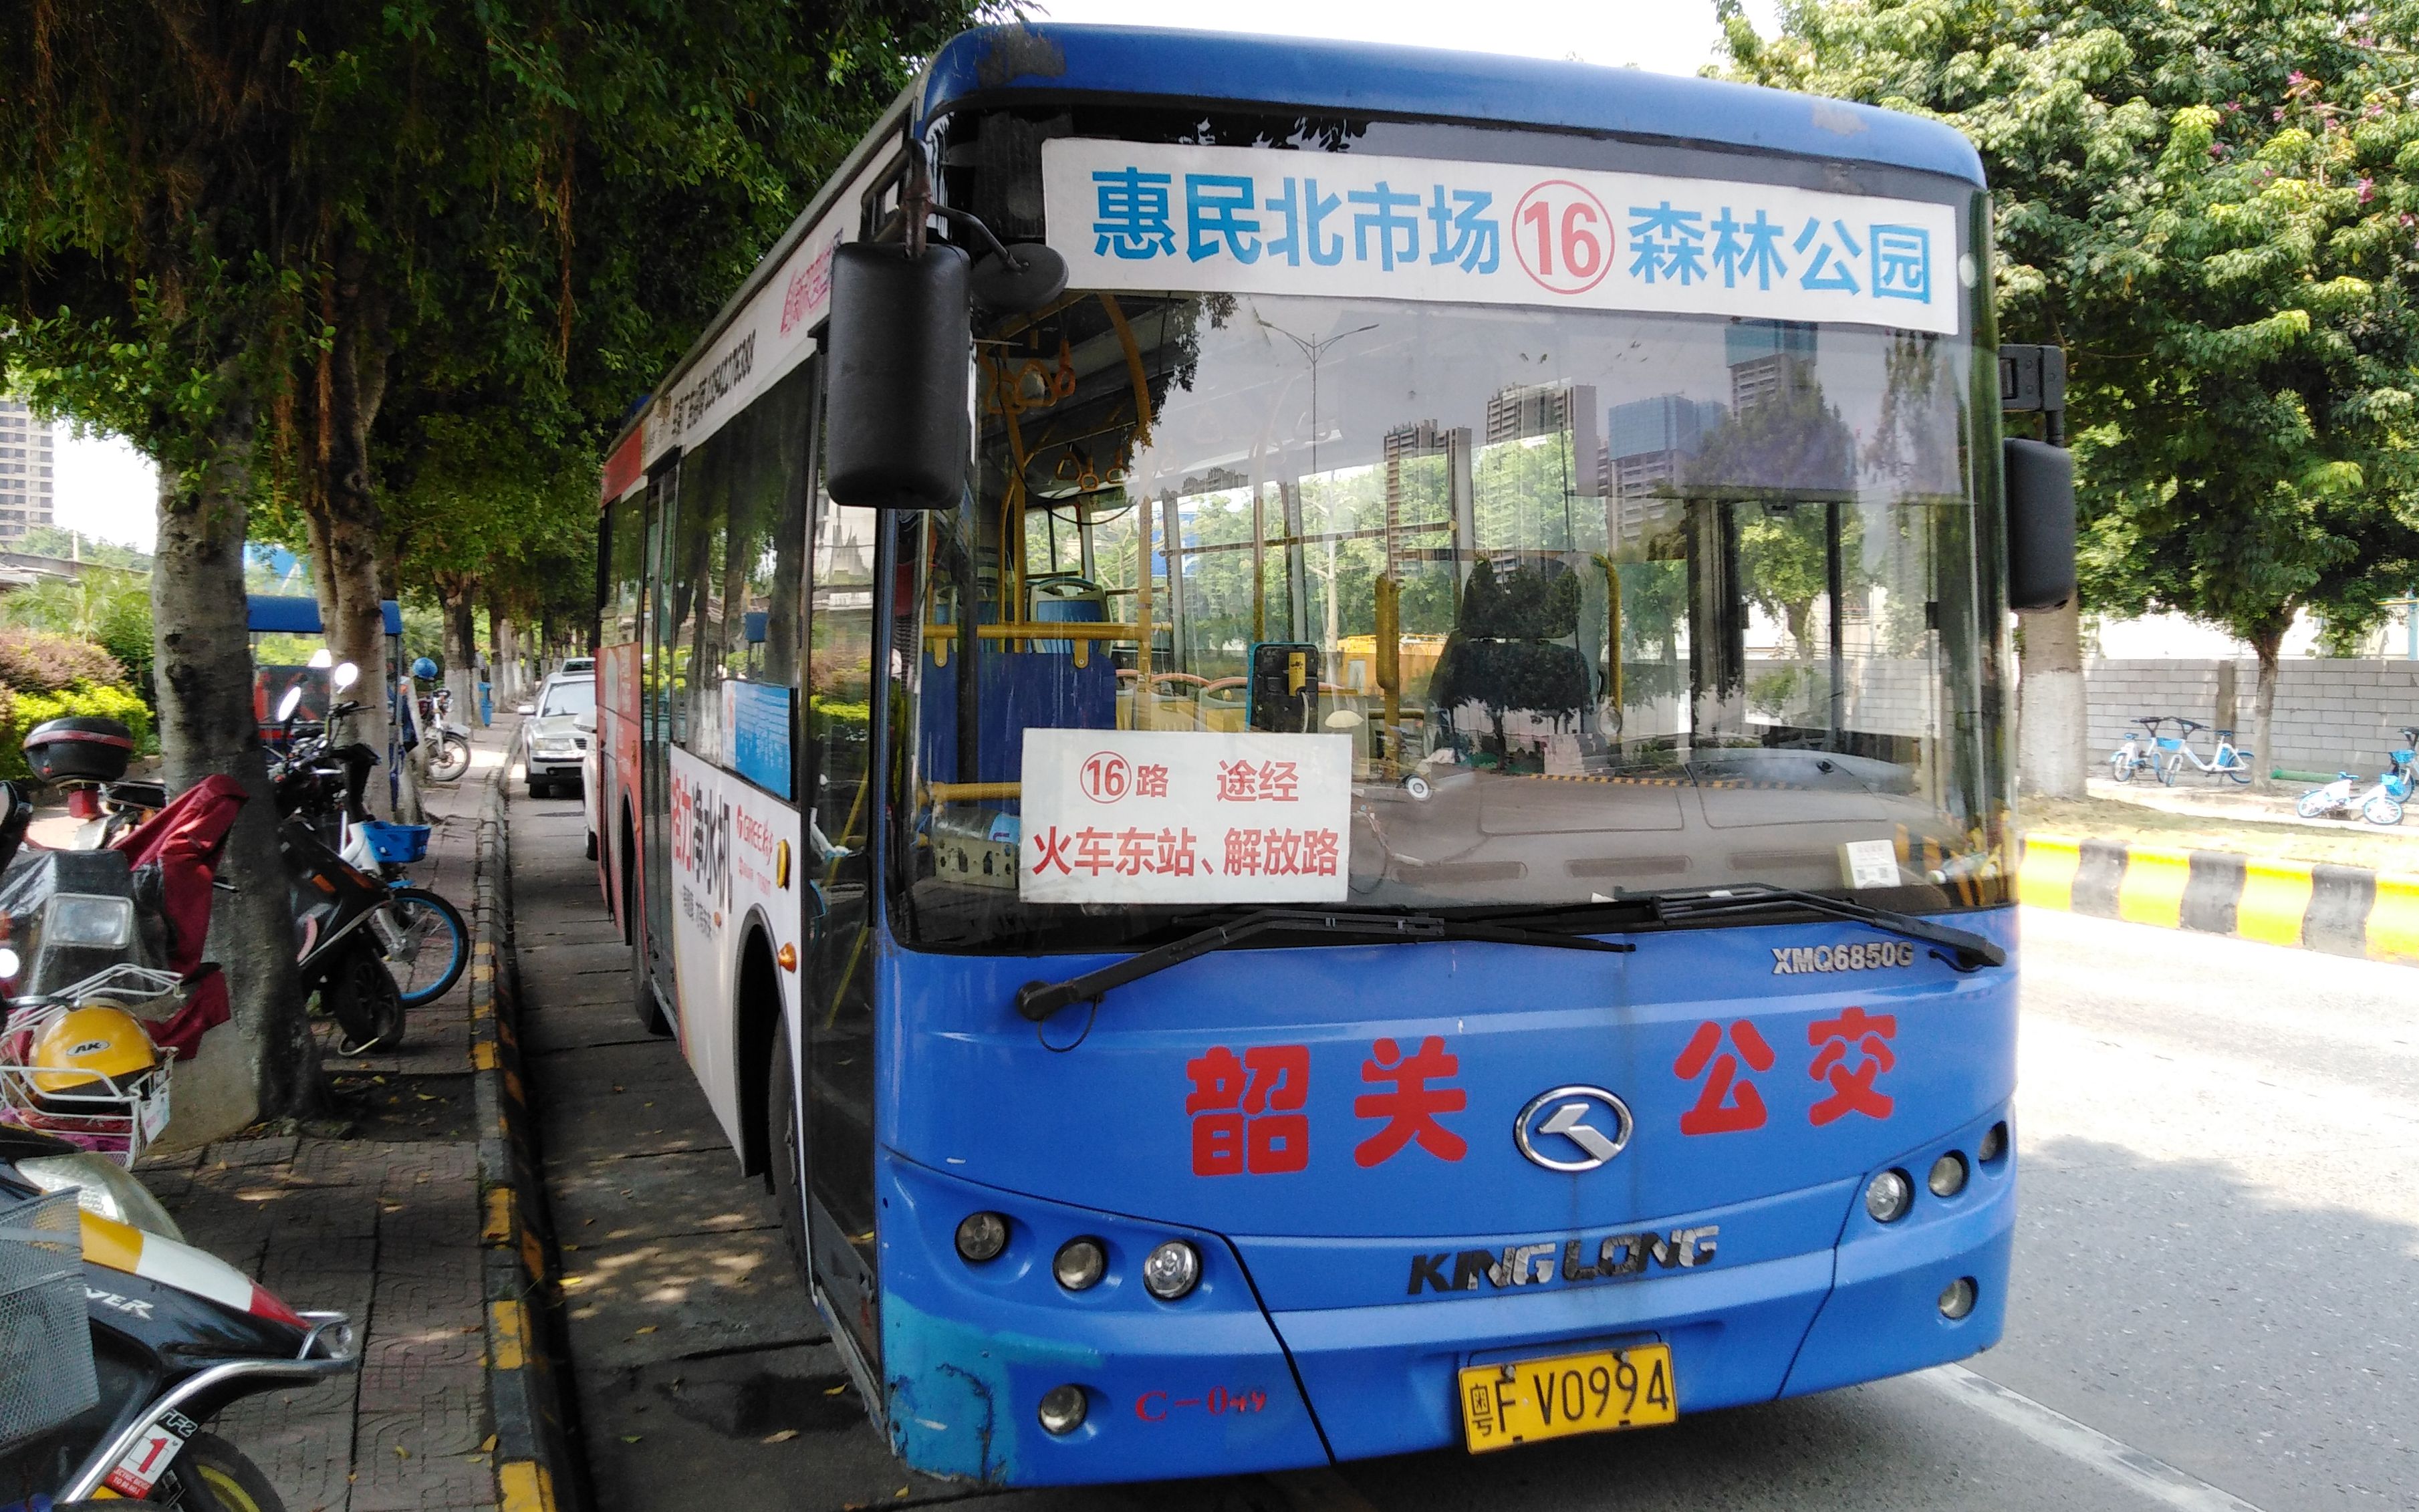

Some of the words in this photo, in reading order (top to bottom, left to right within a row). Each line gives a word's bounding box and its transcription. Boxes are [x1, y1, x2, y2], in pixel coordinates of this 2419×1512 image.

[1091, 166, 1500, 275] 惠民北市场
[1521, 198, 1603, 280] 16
[1628, 201, 1932, 305] 森林公园
[1216, 759, 1299, 802] 途经
[1032, 825, 1340, 877] 火车东站、解放路
[1771, 941, 1914, 975] XMQ6850G
[1186, 1035, 1469, 1177] 韶关
[1672, 1005, 1897, 1136] 公交
[1407, 1242, 1557, 1295] KING
[1562, 1225, 1720, 1281] LONG
[1533, 1358, 1670, 1426] V0994
[137, 1437, 169, 1475] 1
